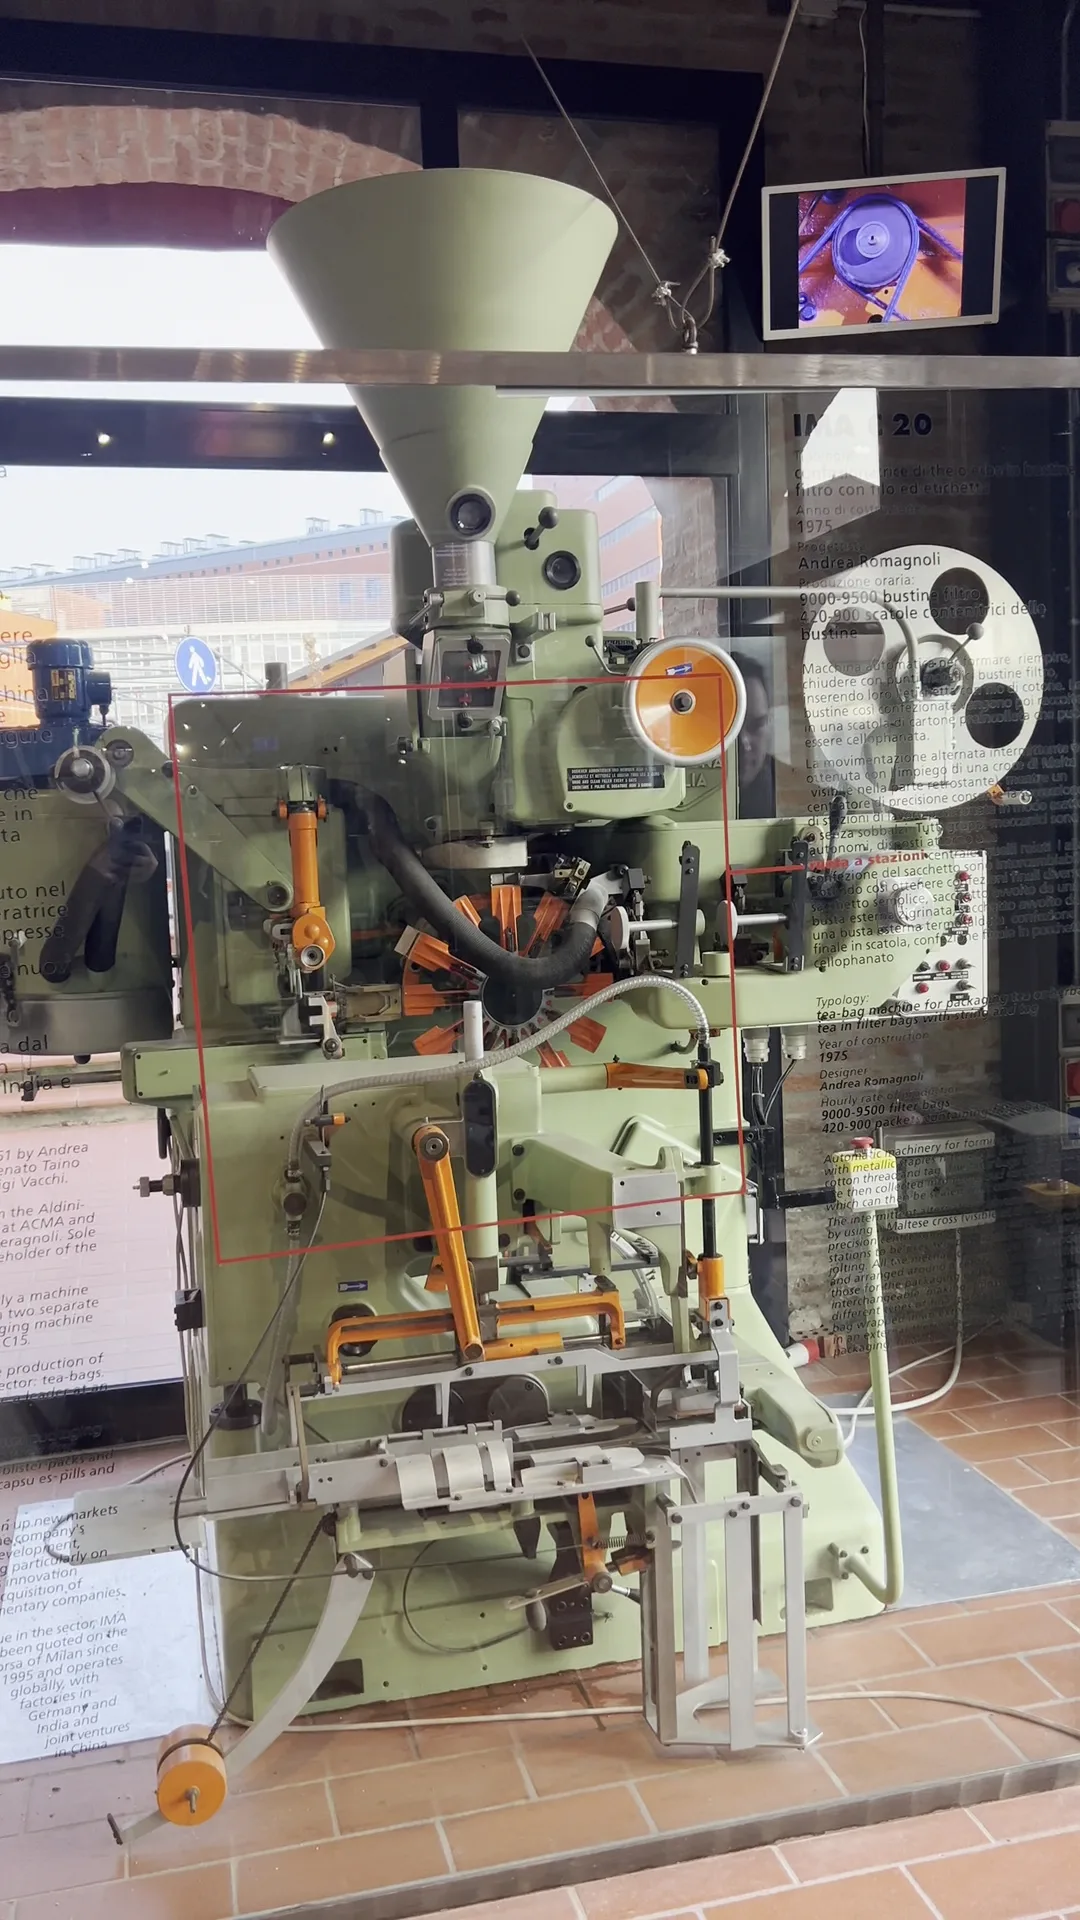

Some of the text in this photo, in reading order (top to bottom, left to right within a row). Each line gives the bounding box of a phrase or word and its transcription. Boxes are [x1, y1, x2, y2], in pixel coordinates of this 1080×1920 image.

[892, 412, 932, 437] 20
[839, 486, 864, 496] con
[901, 482, 918, 495] ed
[796, 505, 830, 515] Anno
[797, 519, 832, 534] 1975
[798, 552, 941, 570] Andrea Romagnoli
[800, 574, 915, 589] Produzione oraria:
[800, 590, 877, 606] 9000-9500
[883, 588, 938, 604] bustine
[801, 604, 918, 624] 420-900 scatole
[801, 626, 858, 641] bustine
[803, 677, 857, 690] chiudere
[978, 668, 1022, 681] bustine
[804, 690, 864, 704] inserendo
[868, 688, 892, 700] loro
[820, 720, 843, 732] una
[805, 735, 843, 748] essere
[931, 748, 986, 762] alternata
[952, 762, 989, 774] di una
[858, 781, 887, 795] nella
[889, 793, 948, 808] precisione
[14, 804, 33, 821] in
[808, 814, 819, 827] di
[868, 848, 925, 865] stazioni
[882, 863, 961, 878] del sacchetto
[36, 879, 66, 898] nel
[812, 913, 845, 926] busta
[813, 925, 873, 941] una busta
[813, 935, 910, 955] finale in scatola,
[813, 951, 894, 969] cellophanato
[816, 993, 870, 1009] Typology:
[816, 998, 942, 1021] tea-bag machine for
[817, 1022, 837, 1034] tea
[840, 1020, 852, 1032] in
[890, 1013, 918, 1029] bags
[923, 1010, 950, 1023] with
[953, 1006, 989, 1022] string
[18, 1034, 48, 1052] dal
[818, 1031, 929, 1050] Year of construction
[819, 1050, 849, 1063] 1975
[61, 1076, 71, 1089] e
[819, 1067, 868, 1082] Designer
[819, 1072, 924, 1091] Andrea Romagnoli
[820, 1092, 883, 1108] Hourly rate
[822, 1097, 950, 1121] 9000-9500 filter bags
[822, 1119, 871, 1134] 420-900
[17, 1142, 89, 1162] by Andrea
[884, 1139, 960, 1158] machinery for
[43, 1158, 81, 1172] Taino
[824, 1160, 895, 1176] with metallic
[21, 1173, 69, 1188] Vacchi.
[825, 1176, 860, 1188] cotton
[847, 1186, 875, 1198] then
[11, 1199, 85, 1218] the Aldini-
[826, 1198, 881, 1211] which can
[2, 1212, 95, 1234] at ACMA and
[827, 1229, 841, 1241] by
[844, 1225, 873, 1239] using
[932, 1214, 958, 1226] cross
[828, 1216, 847, 1227] The
[67, 1227, 96, 1240] Sole
[55, 1241, 97, 1256] of the
[827, 1237, 878, 1253] precision
[829, 1249, 872, 1263] stations
[830, 1267, 904, 1287] and arranged
[17, 1285, 89, 1304] a machine
[831, 1285, 860, 1298] those
[8, 1298, 100, 1319] two separate
[34, 1313, 93, 1330] machine
[832, 1321, 853, 1333] bag
[2, 1334, 30, 1348] C15.
[6, 1352, 104, 1378] production of
[43, 1368, 105, 1385] tea-bags.
[89, 1449, 114, 1462] and
[89, 1463, 115, 1476] and
[34, 1504, 118, 1527] new markets
[15, 1524, 85, 1543] company's
[12, 1548, 108, 1574] particularly on
[5, 1567, 78, 1587] innovation
[68, 1578, 83, 1591] of
[16, 1612, 127, 1642] in the sector, IMA
[35, 1633, 83, 1656] quoted
[87, 1631, 103, 1642] on
[107, 1626, 128, 1638] the
[28, 1642, 119, 1667] of Milan since
[2, 1655, 124, 1685] 1995 and operates
[10, 1672, 99, 1700] globally, with
[19, 1687, 92, 1710] factories in
[28, 1695, 118, 1722] Germany and
[36, 1712, 99, 1734] India and
[44, 1720, 131, 1750] joint ventures
[71, 1739, 108, 1756] China
